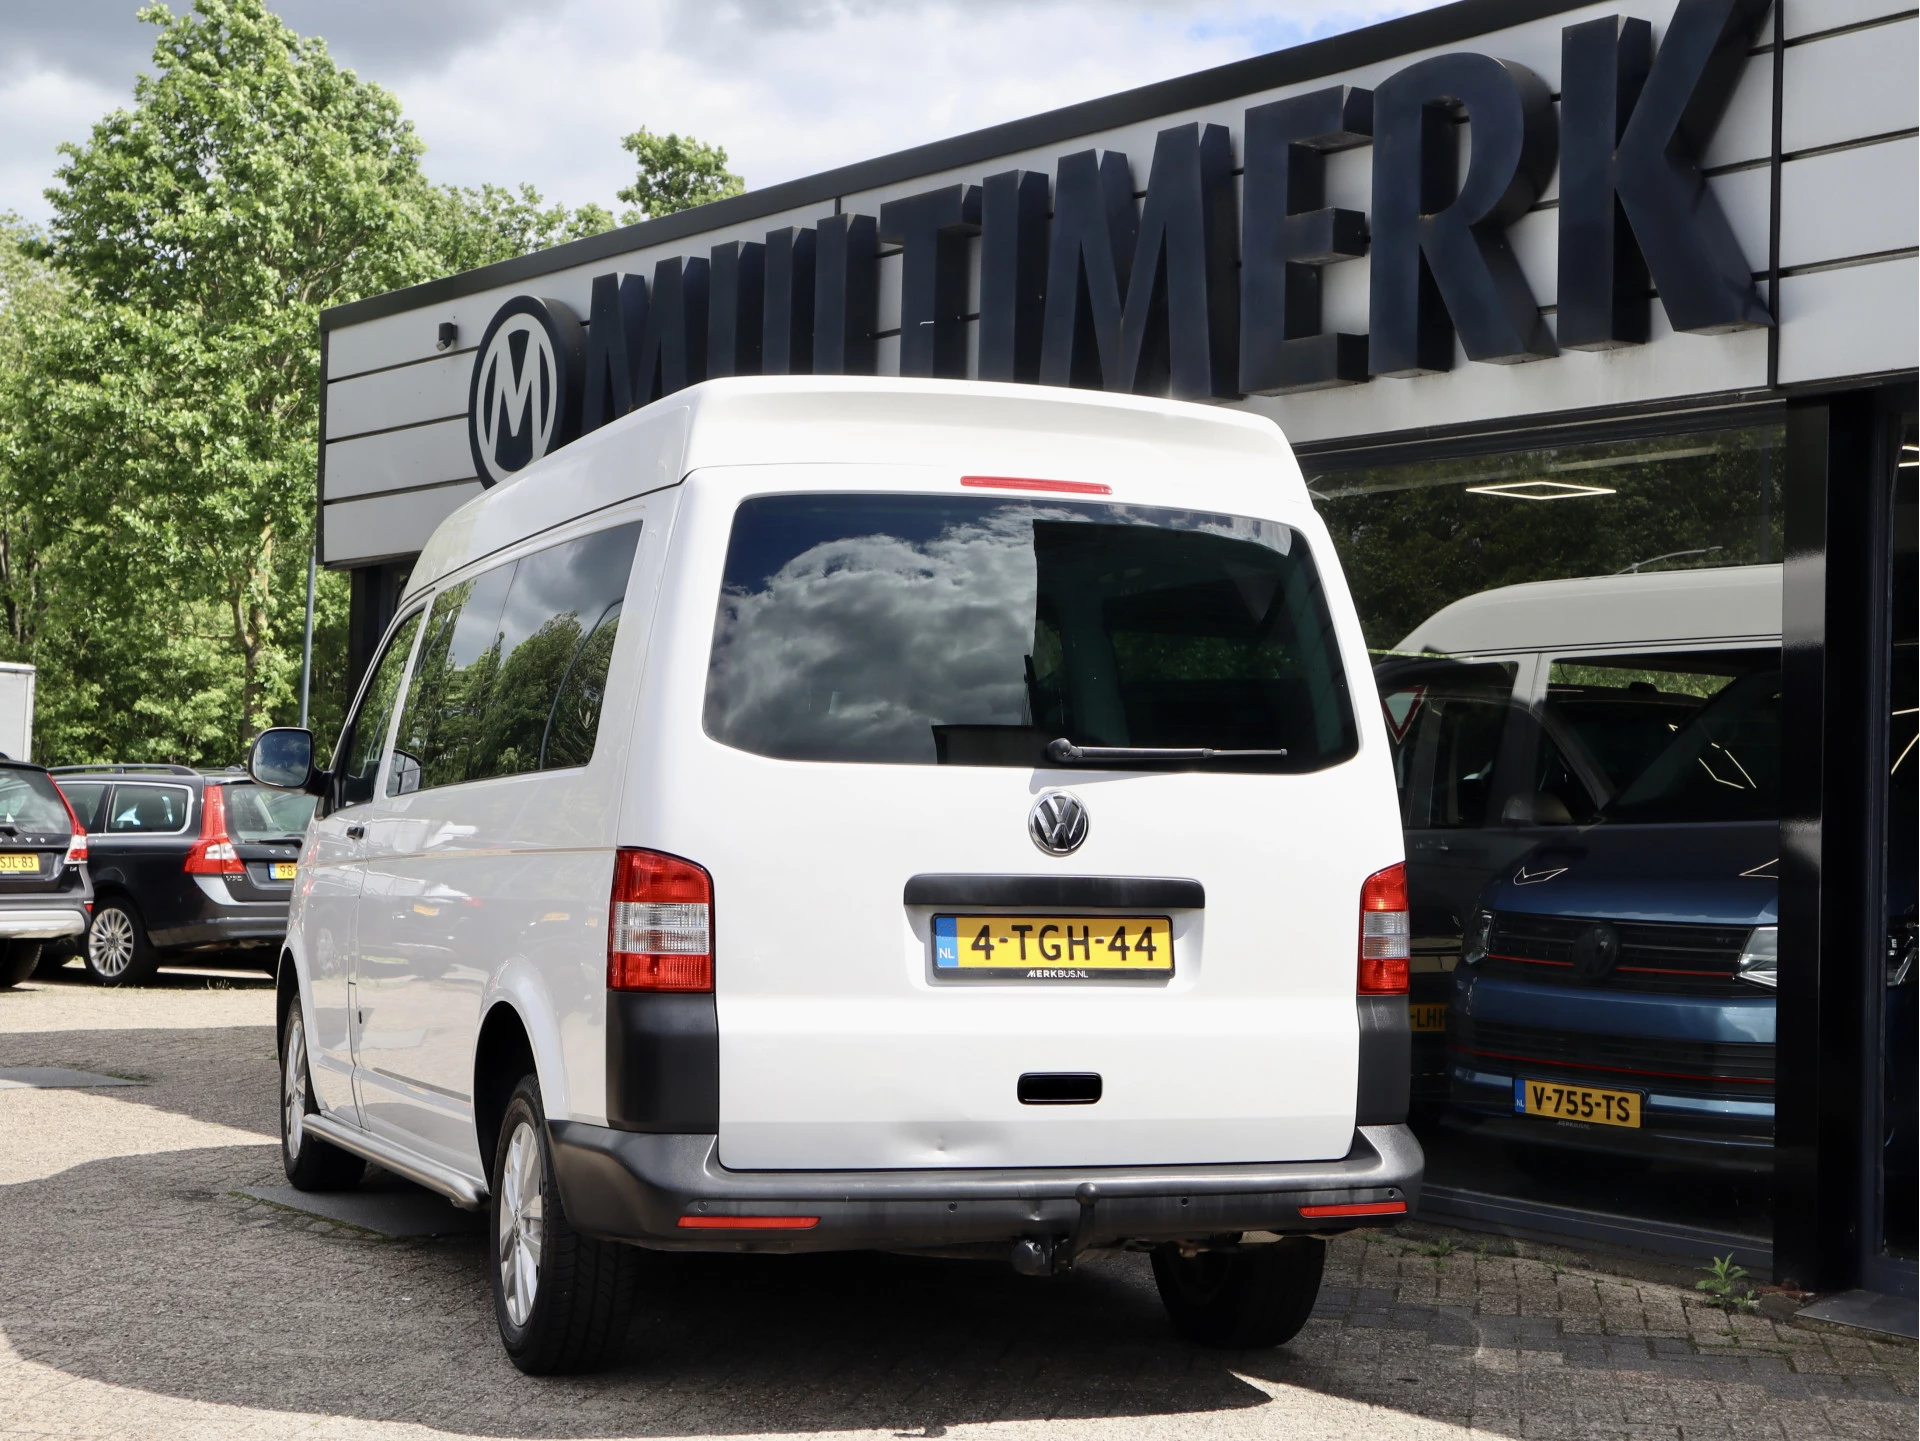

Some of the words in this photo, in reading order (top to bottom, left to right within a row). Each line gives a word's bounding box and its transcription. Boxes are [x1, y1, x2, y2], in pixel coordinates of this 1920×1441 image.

[938, 947, 955, 959] NL
[971, 924, 1157, 961] 4-TGH-44
[1532, 1085, 1630, 1122] V-755-TS
